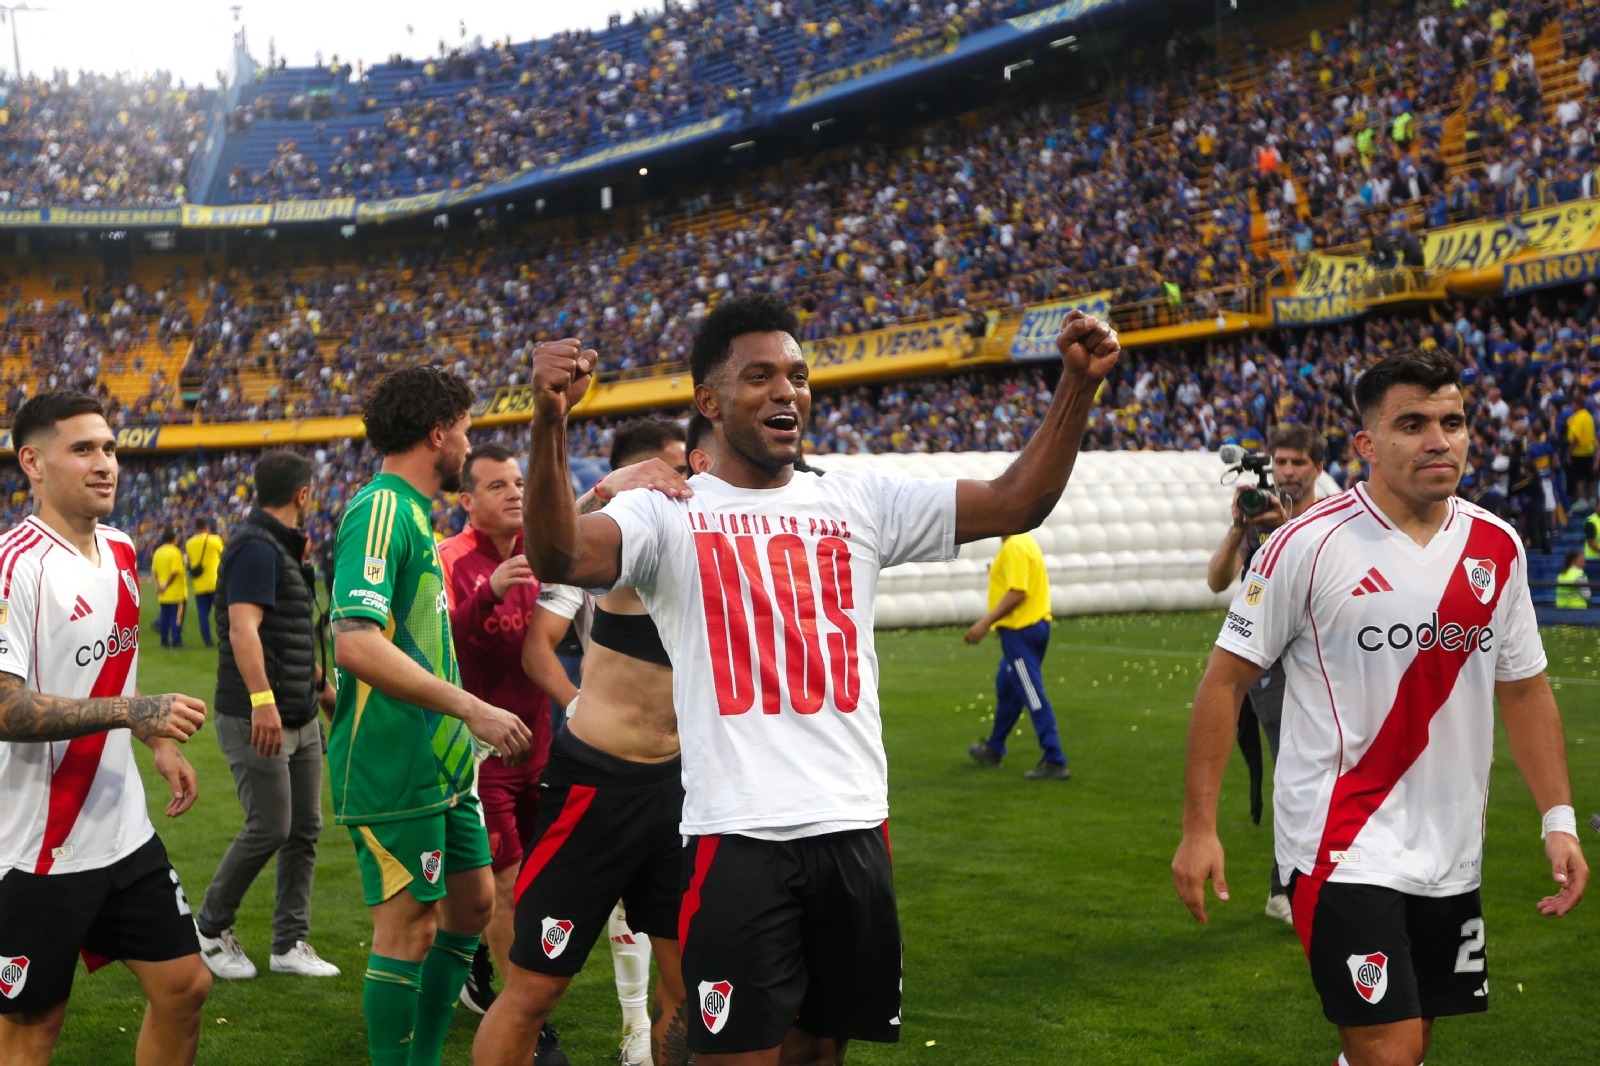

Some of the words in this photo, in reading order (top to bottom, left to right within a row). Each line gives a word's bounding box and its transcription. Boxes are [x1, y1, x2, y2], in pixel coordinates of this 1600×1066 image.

[116, 427, 158, 448] SOY
[689, 512, 708, 531] LA
[711, 512, 772, 534] LORIA
[349, 589, 389, 605] ASSIST
[361, 598, 389, 614] CARD
[693, 531, 861, 716] DIOS
[1228, 610, 1254, 627] SSIST
[1357, 610, 1494, 652] codere
